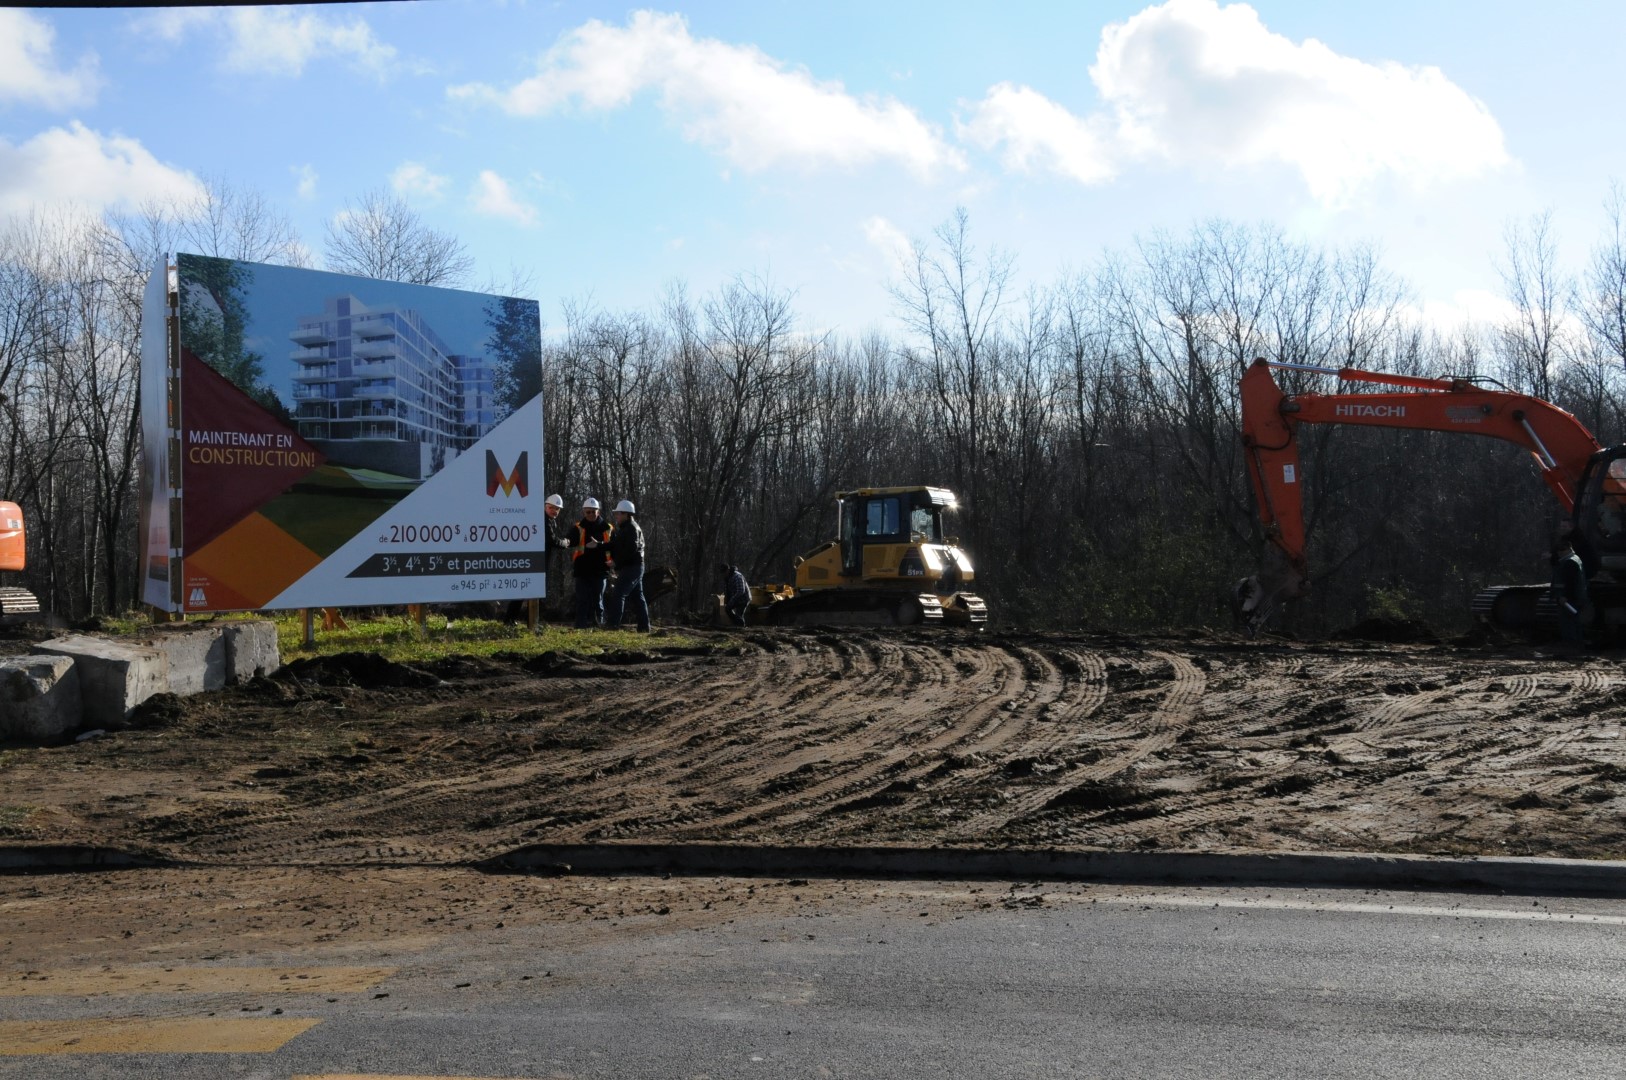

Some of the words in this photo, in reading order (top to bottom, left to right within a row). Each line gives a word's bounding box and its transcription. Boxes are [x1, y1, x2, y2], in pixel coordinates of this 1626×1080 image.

[1336, 404, 1406, 417] HITACHI
[189, 430, 274, 447] MAINTENANT
[276, 434, 292, 448] EN
[189, 447, 315, 468] CONSTRUCTION!
[379, 535, 388, 543] de
[447, 559, 460, 570] et
[464, 556, 531, 573] penthouses
[460, 579, 476, 590] 945
